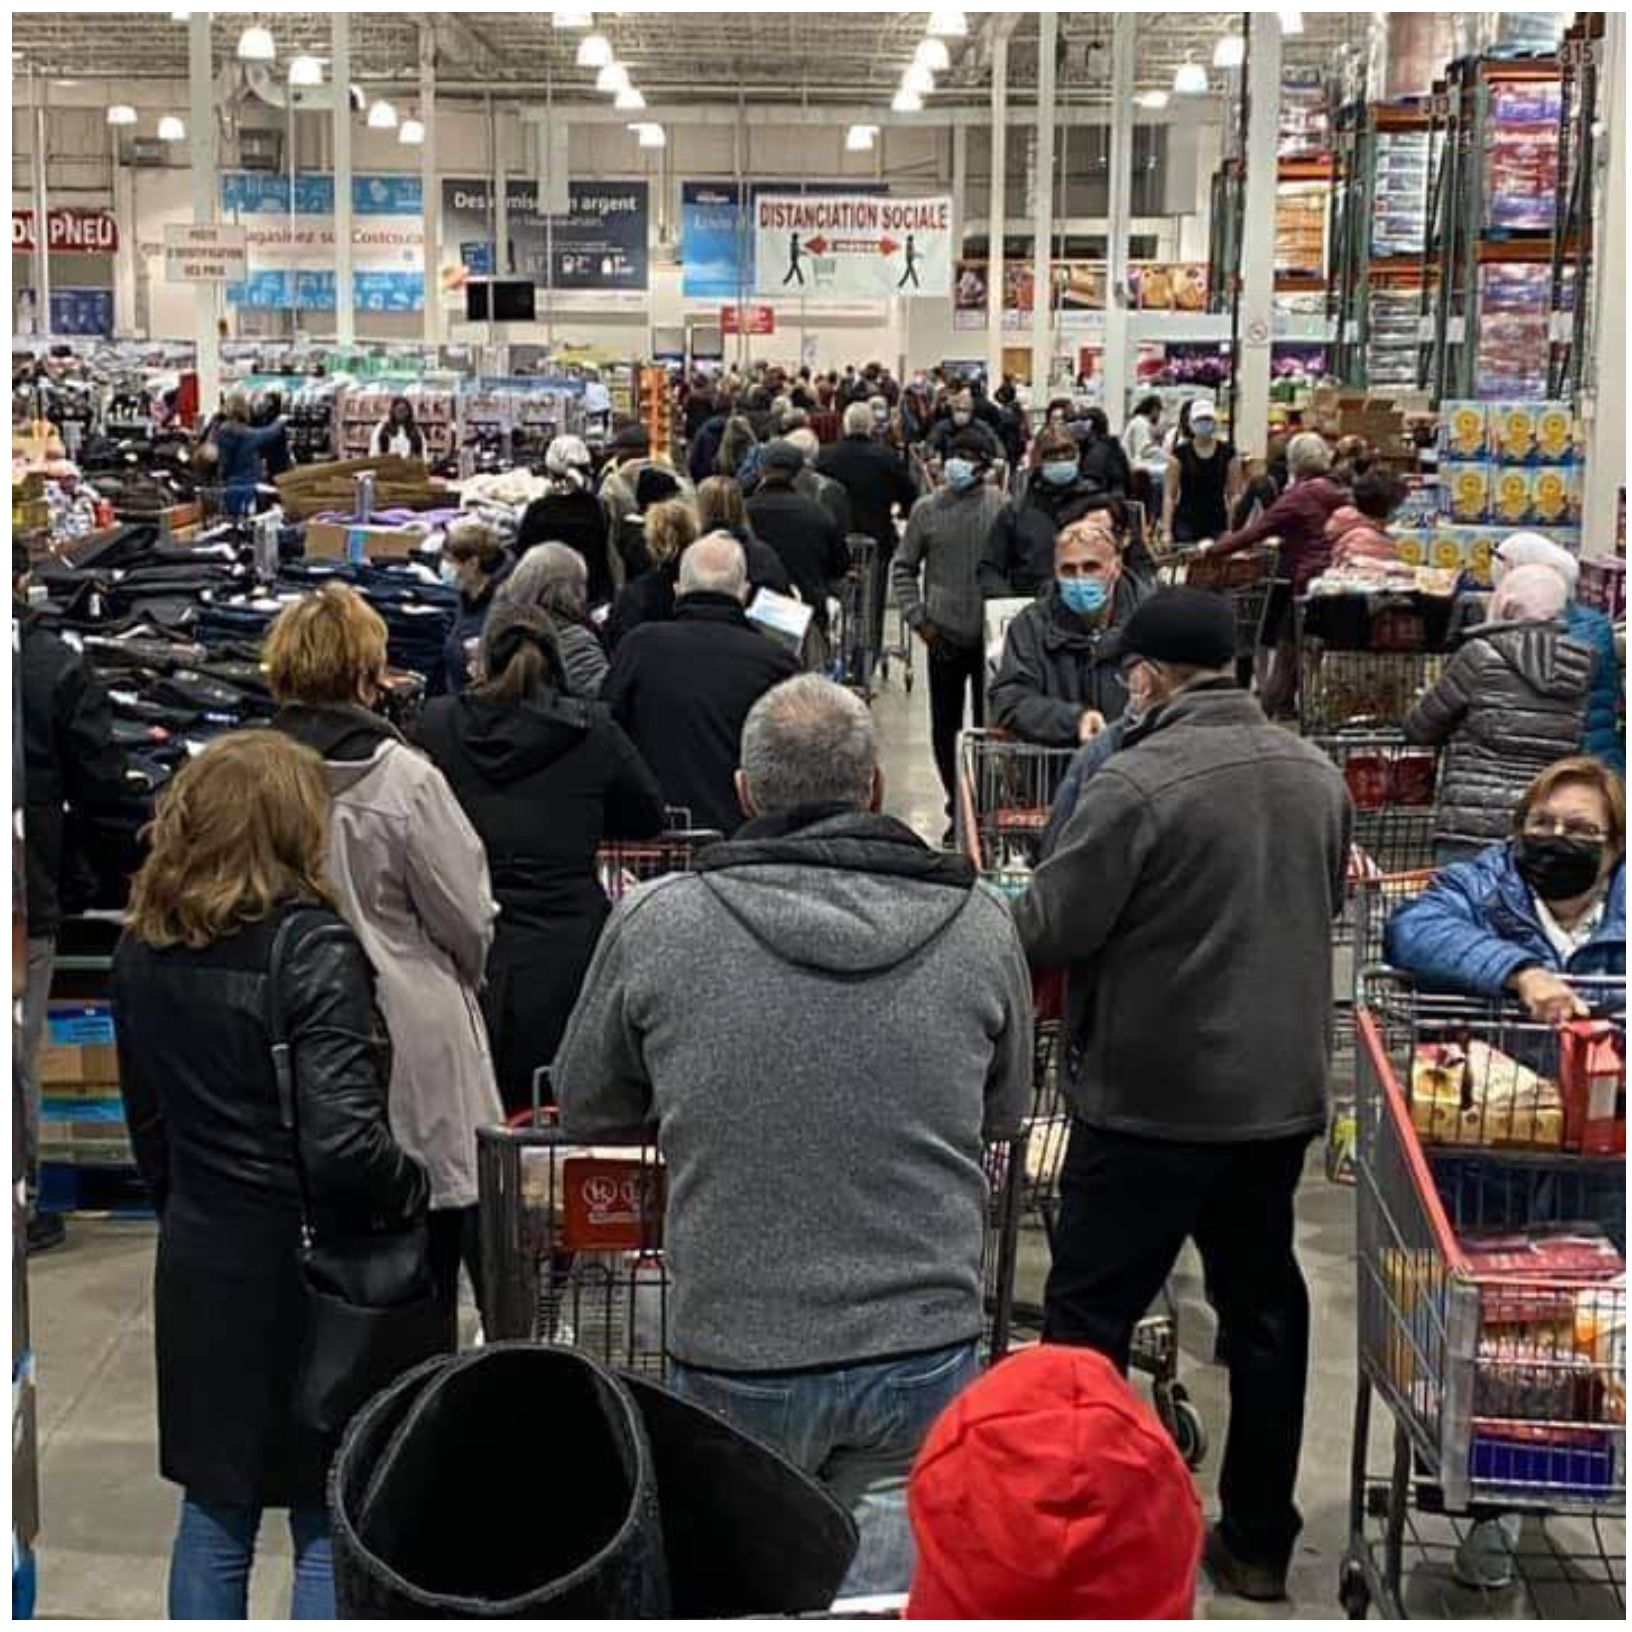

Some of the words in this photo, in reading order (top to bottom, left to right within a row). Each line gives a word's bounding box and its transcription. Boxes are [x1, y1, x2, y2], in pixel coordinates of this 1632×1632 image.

[455, 192, 485, 209] Des
[582, 196, 636, 215] argent
[760, 203, 878, 229] DISTANCIATION
[881, 205, 947, 230] SOCIALE
[50, 217, 113, 246] PNEU
